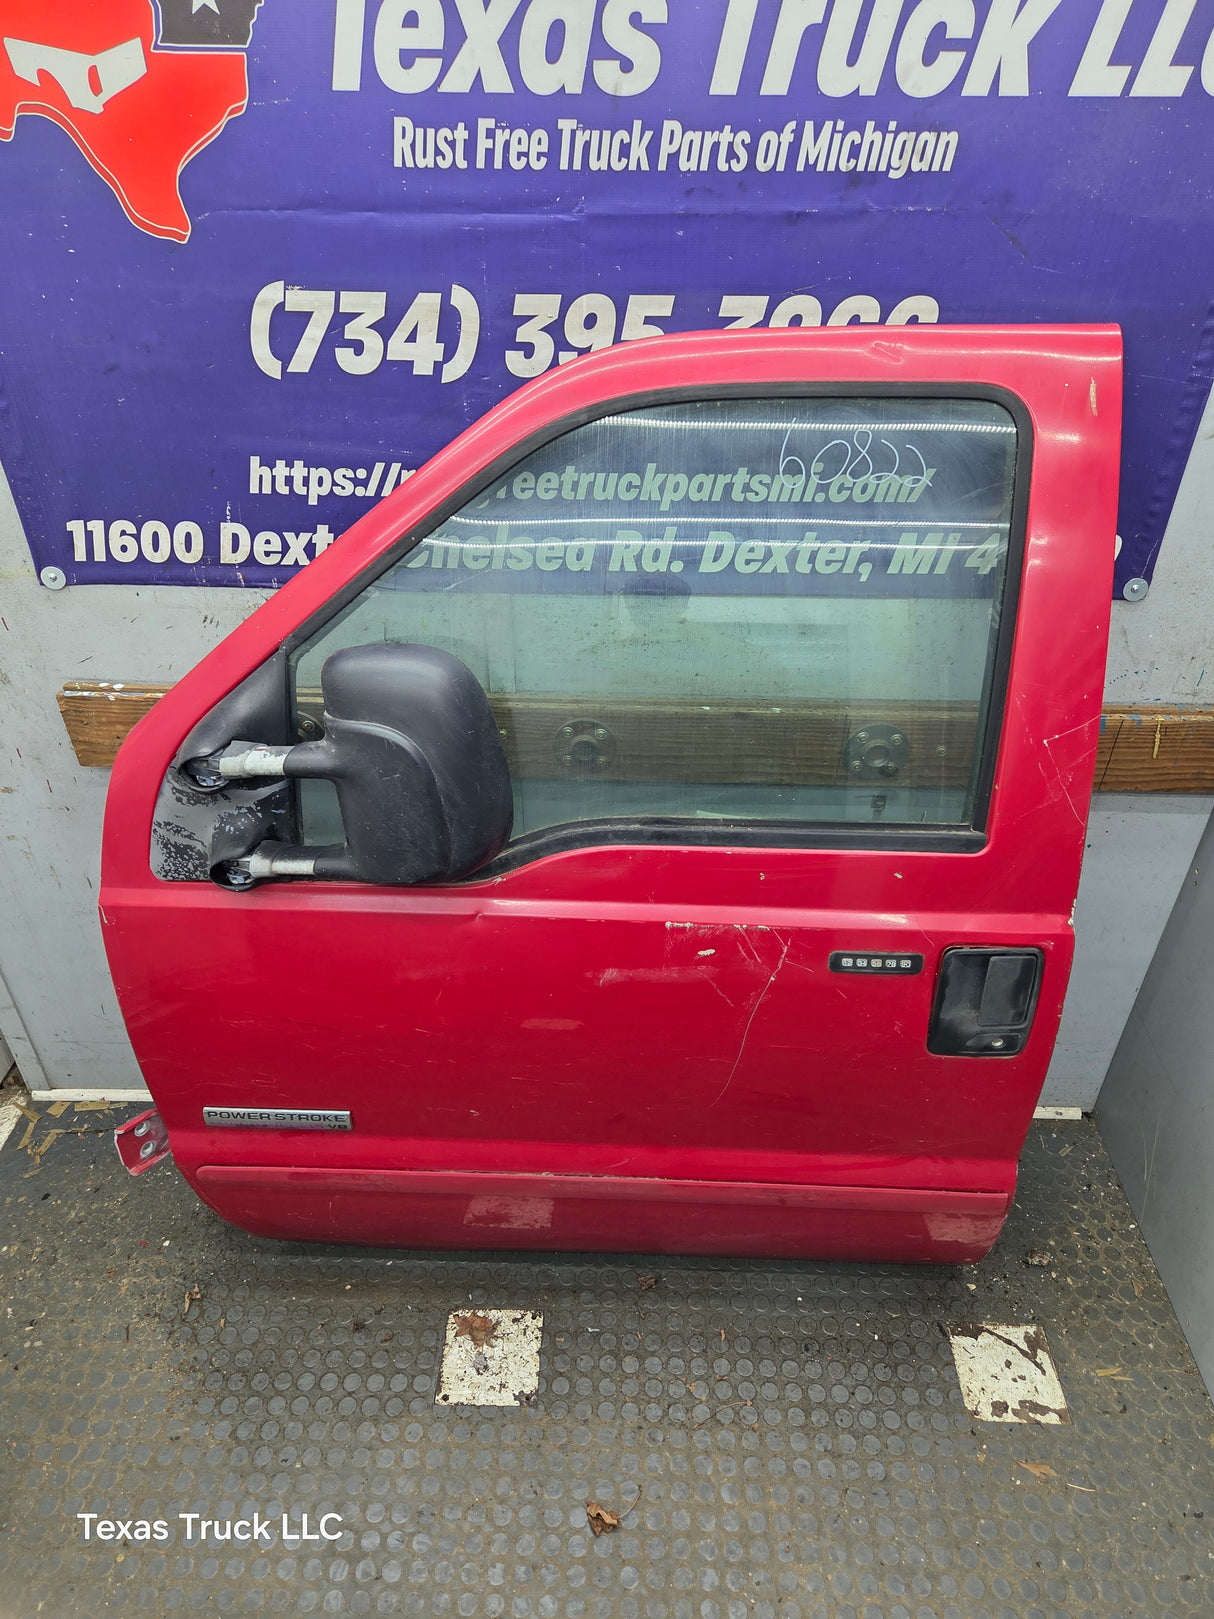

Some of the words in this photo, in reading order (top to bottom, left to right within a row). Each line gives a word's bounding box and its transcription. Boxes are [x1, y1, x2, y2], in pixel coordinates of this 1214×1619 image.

[331, 0, 668, 97] Texas
[708, 0, 1063, 98] Truck
[393, 116, 469, 169] Rust
[475, 117, 549, 171] Free
[557, 119, 654, 172] Truck
[657, 119, 752, 173] Parts
[755, 120, 797, 173] of
[795, 119, 959, 180] Michigan
[250, 280, 481, 384] (734)
[779, 417, 933, 489] 60822
[65, 519, 203, 563] 11600
[219, 522, 344, 567] Dext
[608, 526, 685, 573] Rd.
[698, 531, 873, 583] Dexter,
[886, 532, 962, 575] MI
[207, 1111, 271, 1121] POWER
[275, 1113, 346, 1123] STROKE
